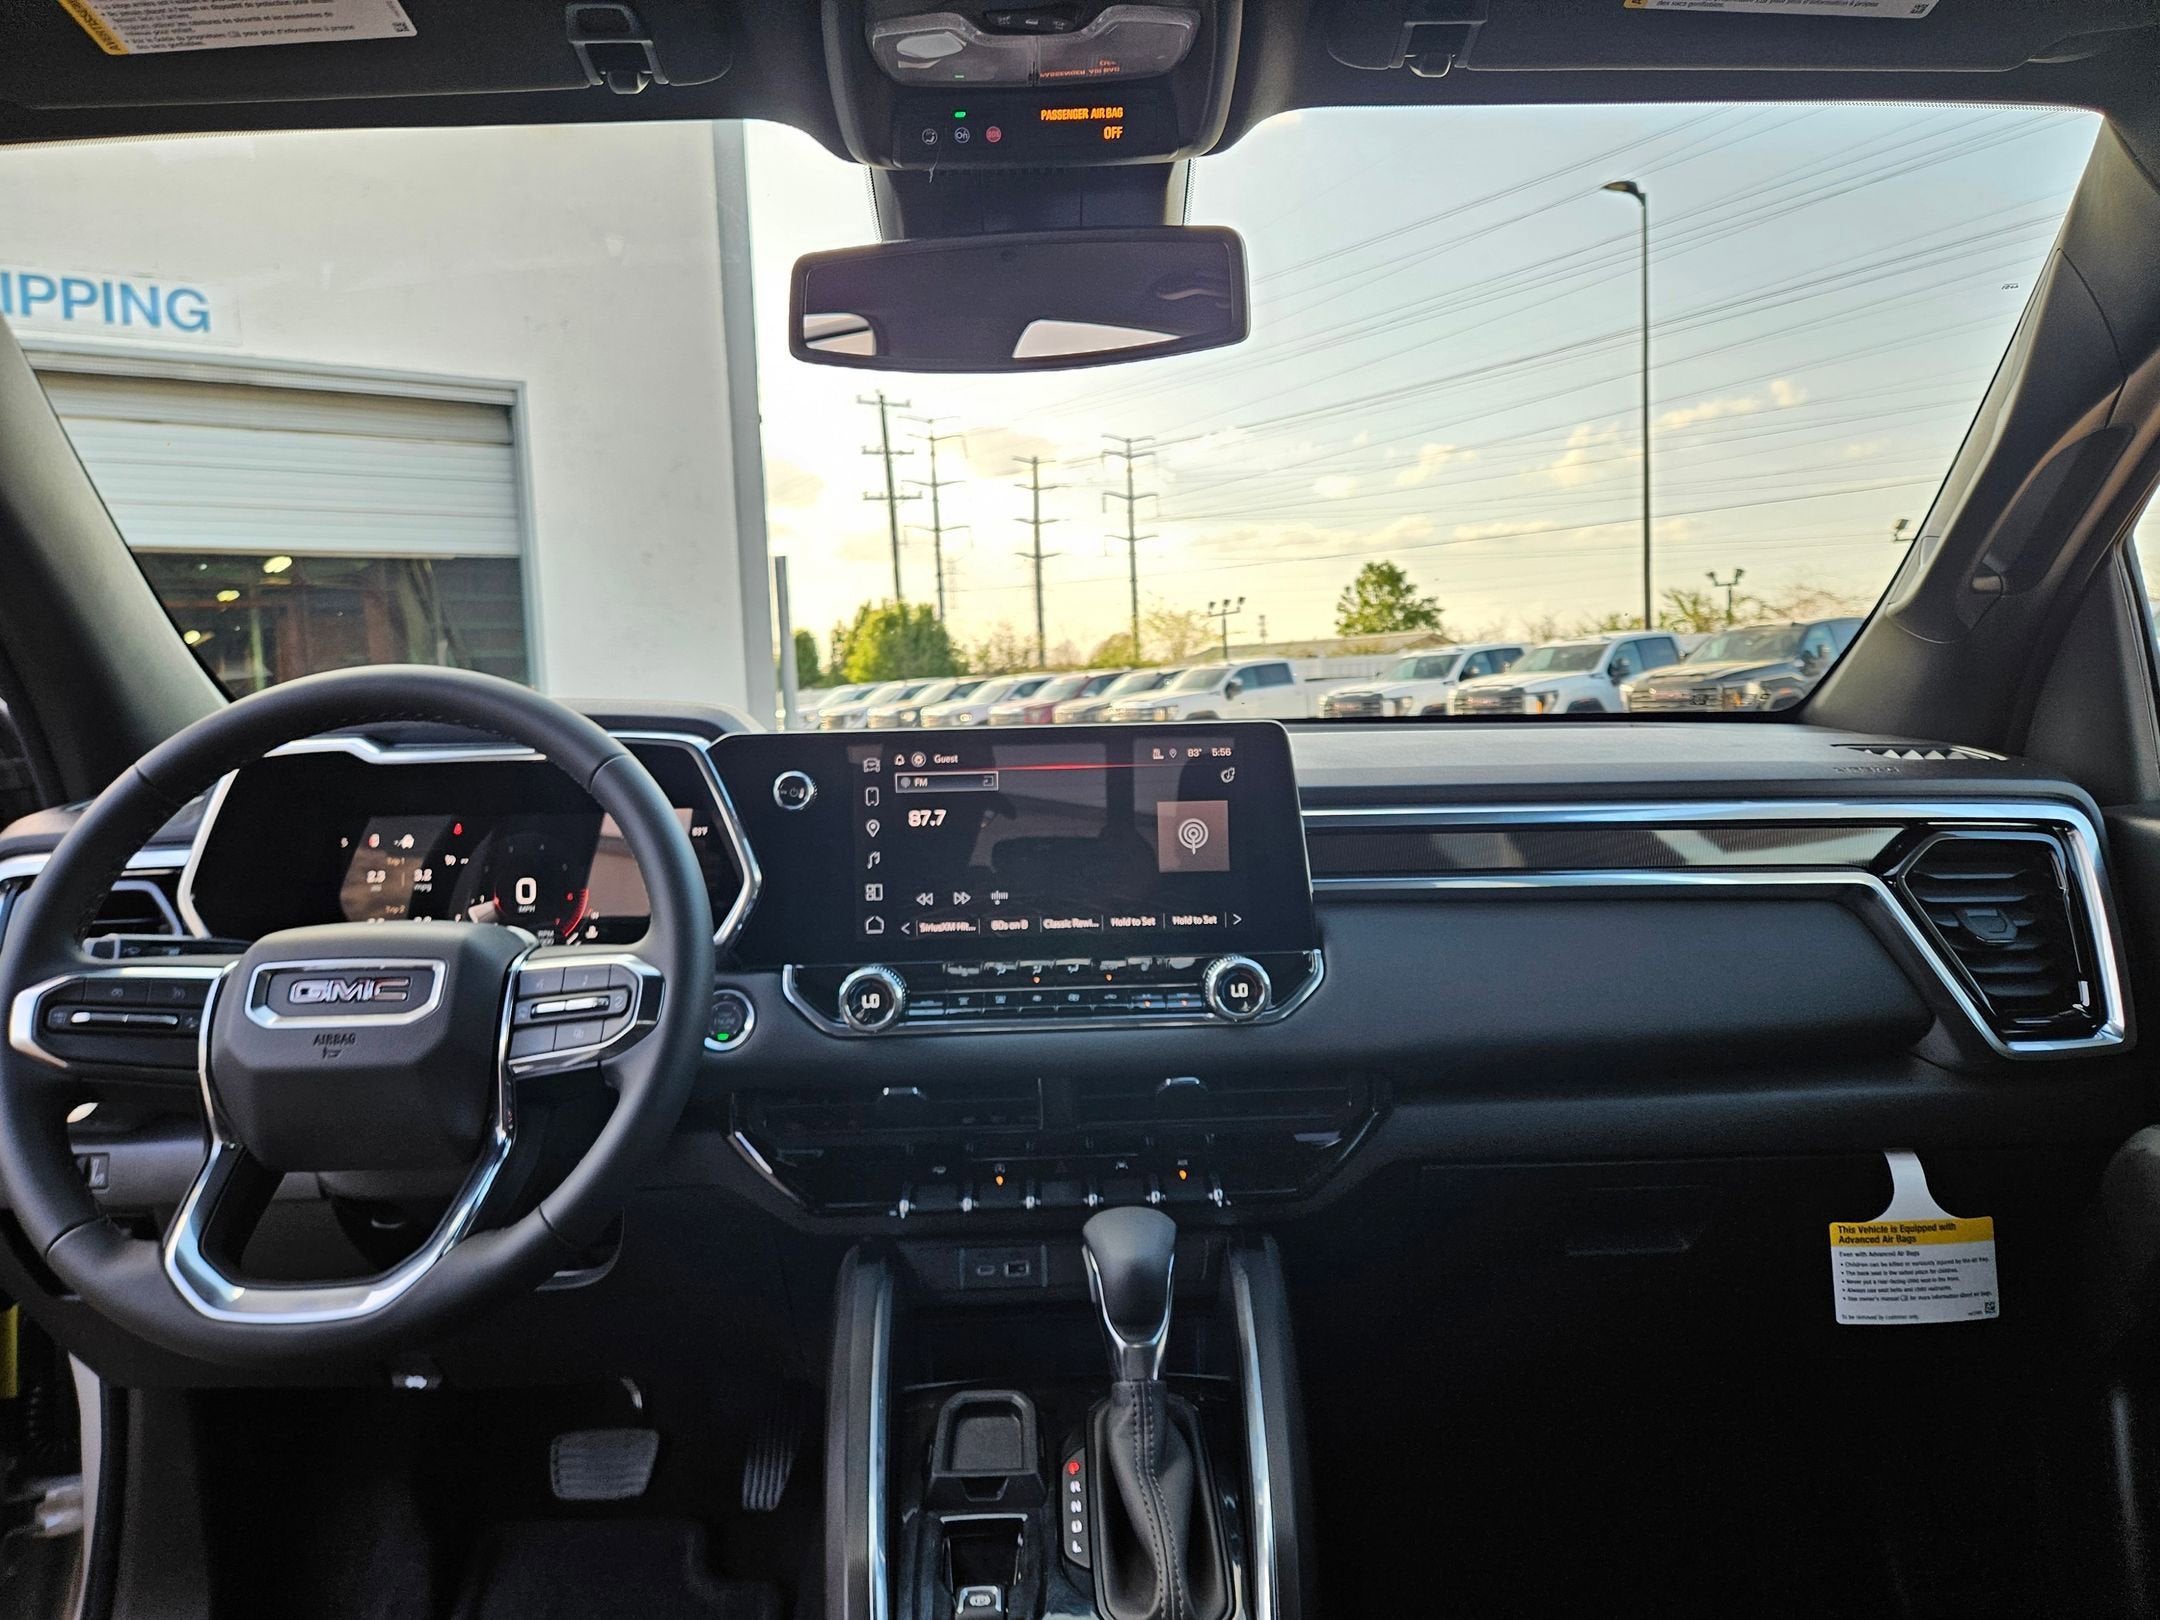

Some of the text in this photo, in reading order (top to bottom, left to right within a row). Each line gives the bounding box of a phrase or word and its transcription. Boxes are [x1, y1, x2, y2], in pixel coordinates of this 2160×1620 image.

[1040, 107, 1124, 121] PASSENGER AIR BAG
[1103, 126, 1124, 140] OFF
[933, 754, 959, 764] Guest
[914, 778, 928, 787] FM
[908, 809, 947, 827] 87.7
[515, 877, 538, 905] 0
[1110, 915, 1156, 927] Hold to Set
[1172, 914, 1217, 925] Hold to Set
[289, 977, 411, 1003] GMC
[312, 1033, 356, 1047] AIRBAG
[1838, 1222, 1956, 1234] This Vehicle is Equipped with
[1838, 1234, 1917, 1244] Advanced Air Bags
[1070, 1480, 1081, 1493] R
[1070, 1500, 1082, 1513] N
